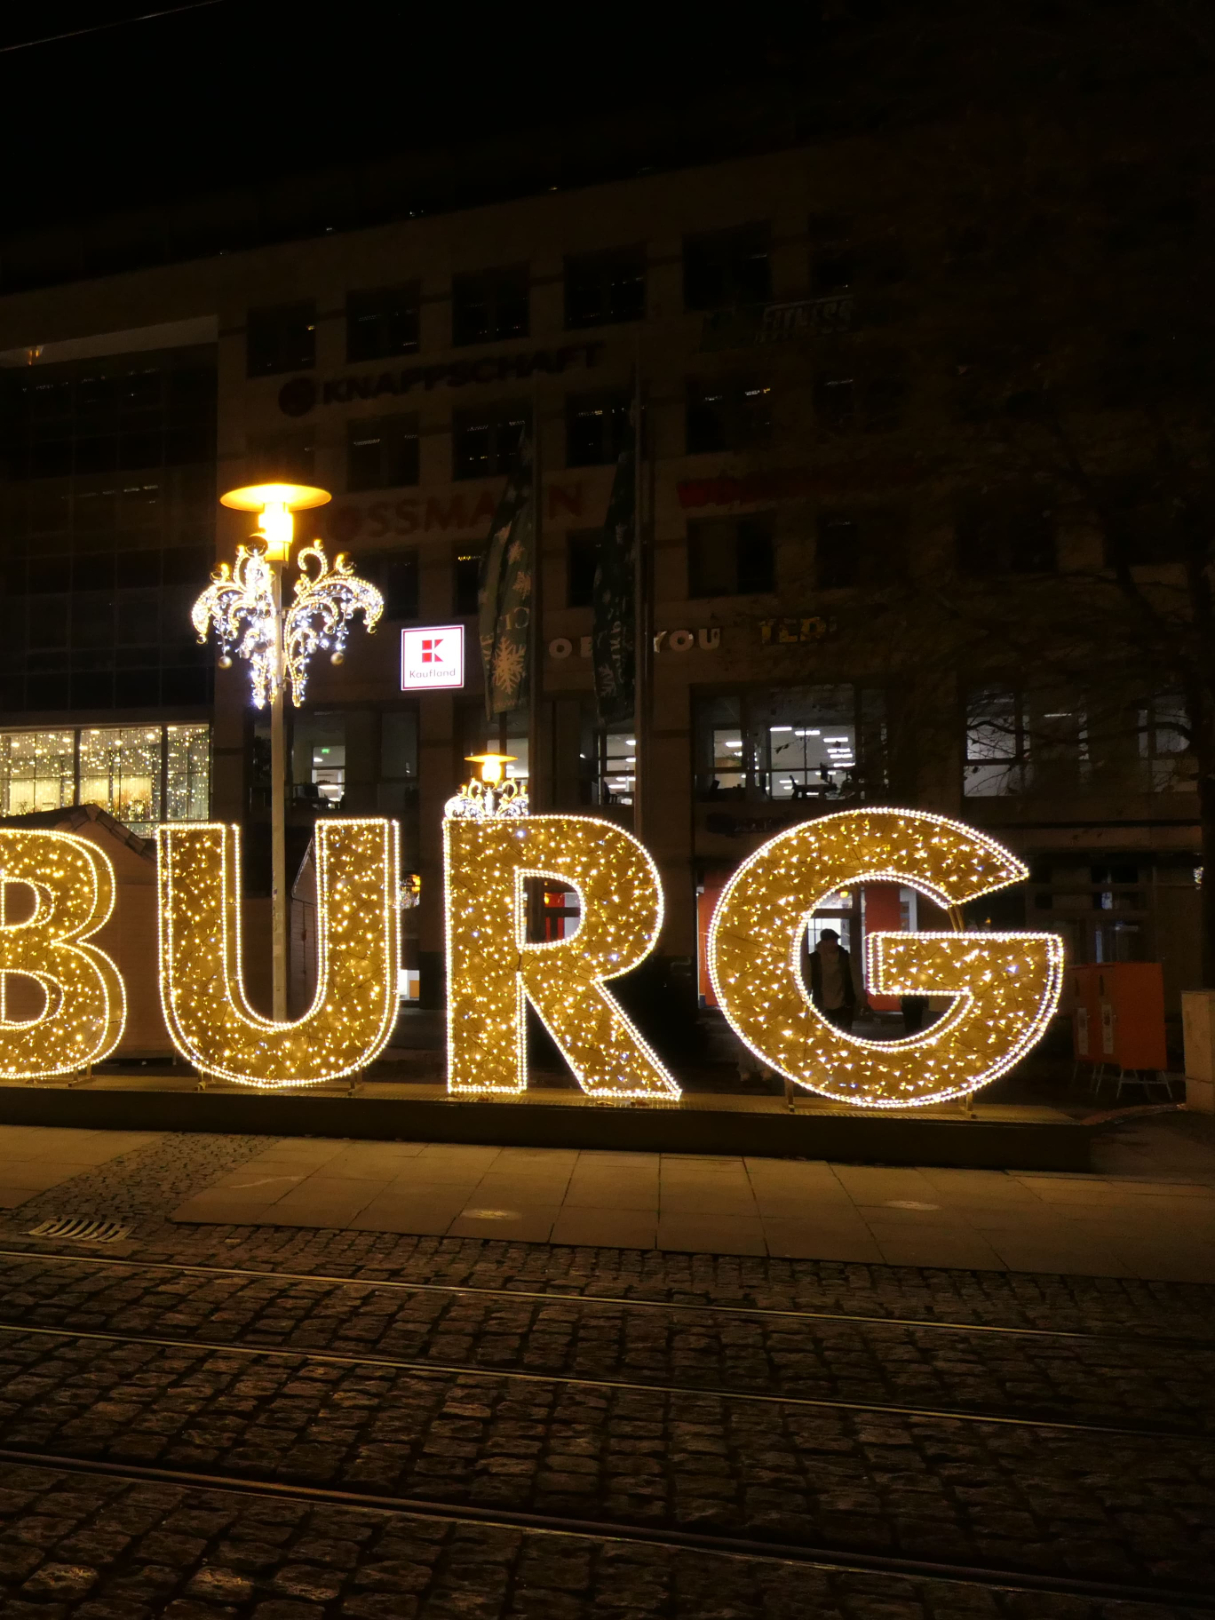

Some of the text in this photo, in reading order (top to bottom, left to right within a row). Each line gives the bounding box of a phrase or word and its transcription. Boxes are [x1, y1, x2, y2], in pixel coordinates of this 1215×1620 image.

[323, 339, 607, 404] KNAPPSCHAFT
[307, 480, 583, 542] OSSMAN
[409, 667, 456, 679] Kaufland
